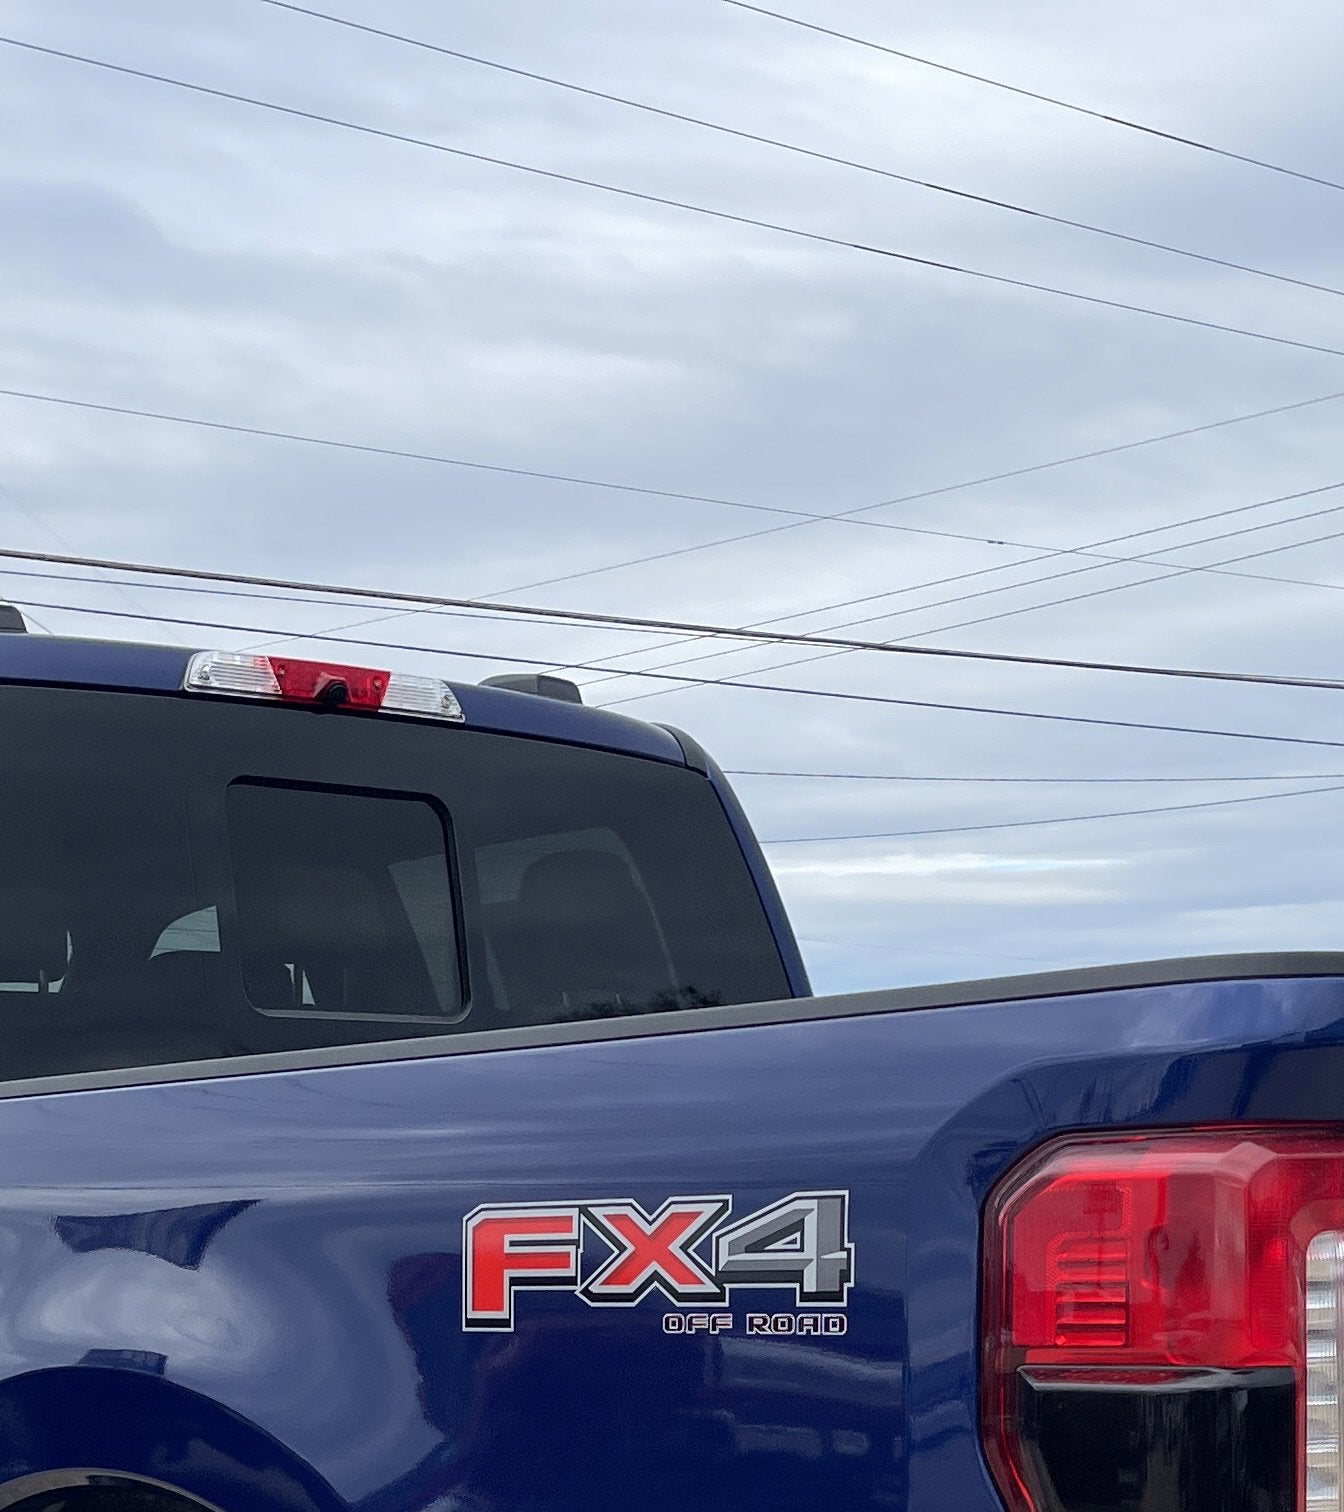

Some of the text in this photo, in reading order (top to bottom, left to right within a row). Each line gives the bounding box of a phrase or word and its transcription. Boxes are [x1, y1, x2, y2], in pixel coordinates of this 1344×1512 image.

[462, 1190, 855, 1332] FX4
[662, 1313, 848, 1336] OFF ROAD
